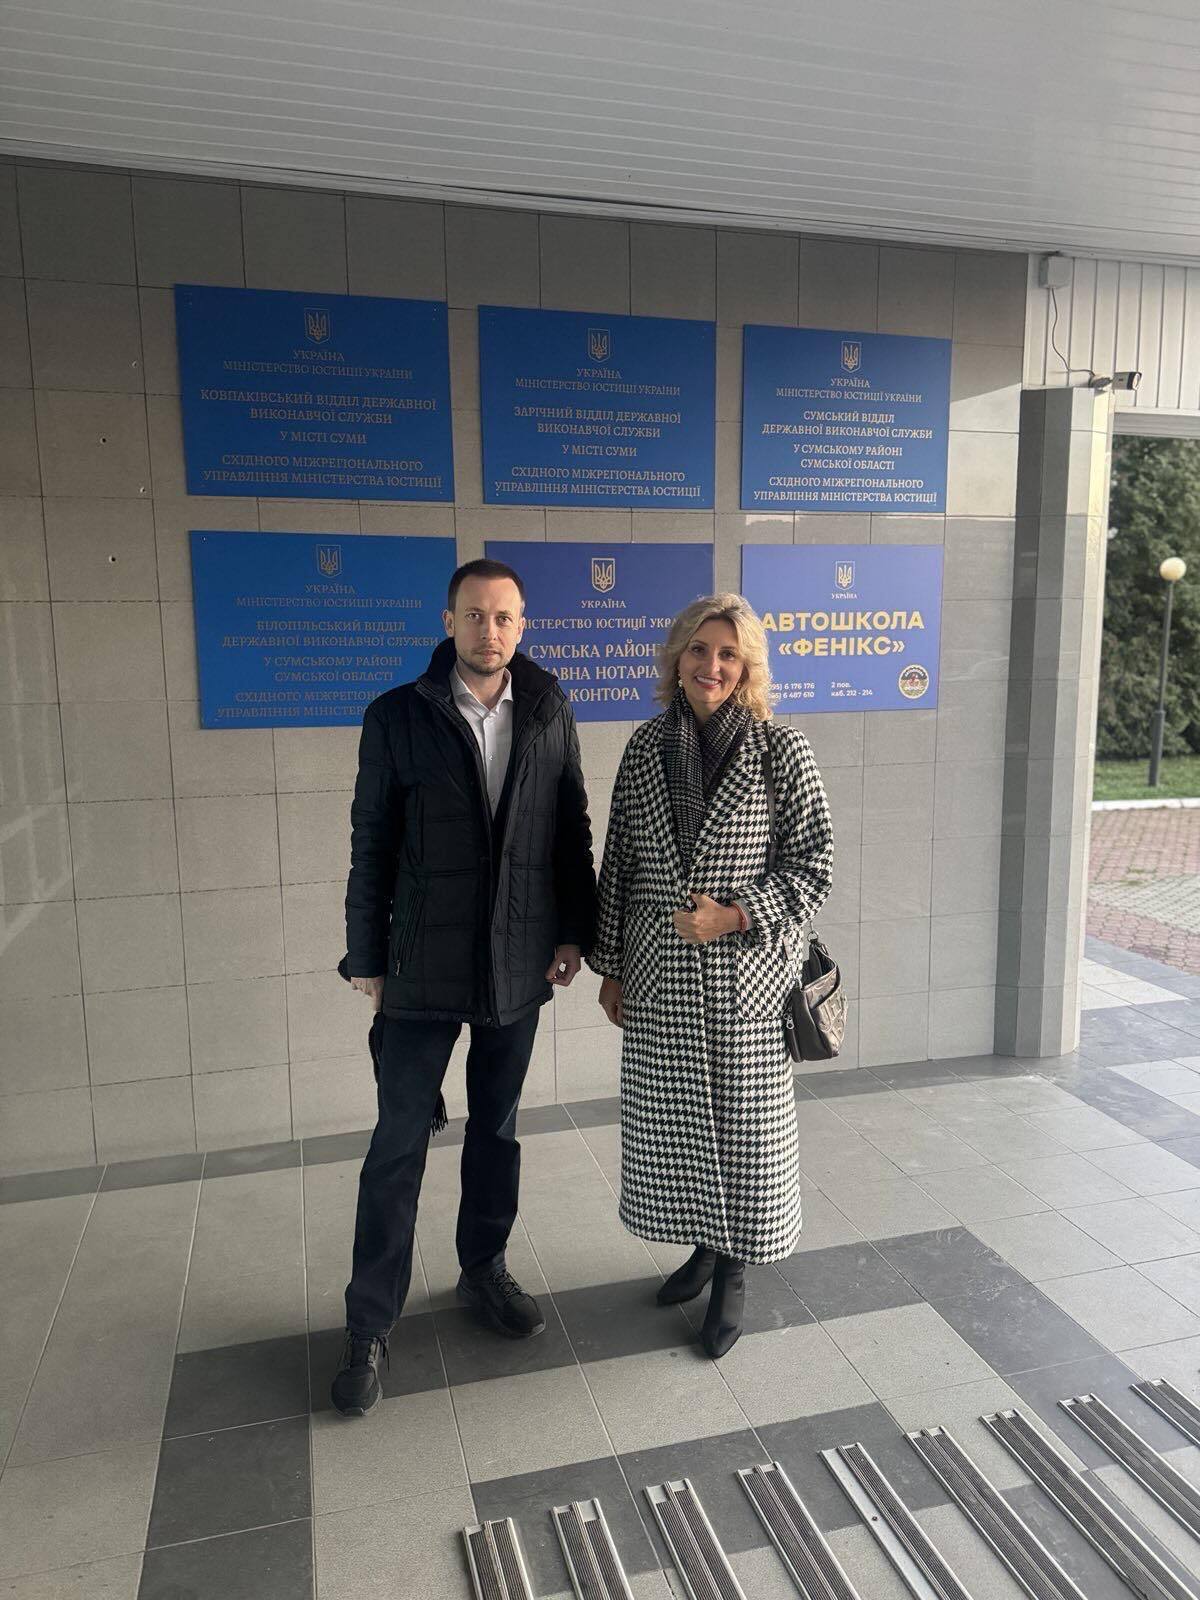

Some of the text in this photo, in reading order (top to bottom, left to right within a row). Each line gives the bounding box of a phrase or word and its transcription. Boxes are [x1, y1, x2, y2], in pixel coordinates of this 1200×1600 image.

[293, 350, 344, 362] УКРАЇНА
[223, 361, 412, 380] МІНІСТЕРСТВО ЮСТИЦІЇ УКРАЇНИ
[577, 367, 621, 379] УКРАЇНА
[515, 378, 680, 395] МІНІСТЕРСТВО ЮСТИЦІЇ УКРАЇНИ
[830, 378, 870, 388] УКРАЇНА
[201, 390, 436, 411] КОВПАКІВСЬКИЙ ВІДДІЛ ДЕРЖАВНОЇ
[776, 388, 921, 402] МІНІСТЕРСТВО ЮСТИЦІЇ УКРАЇНИ
[250, 408, 392, 424] ВИКОНАВЧОЇ СЛУЖБИ
[514, 406, 680, 423] ЗАРІЧНИЙ ВІДДІЛ ДЕРЖАВНОЇ
[804, 411, 894, 423] СУМСЬКИЙ ВІДДІЛ
[280, 431, 366, 444] У МІСТІ СУМИ
[538, 423, 660, 438] ВИКОНАВЧОЇ СЛУЖБИ
[762, 424, 932, 438] ДЕРЖАВНОЇ ВИКОНАВЧОЇ СЛУЖБИ
[562, 445, 637, 456] У МІСТІ СУМИ
[794, 444, 902, 456] У СУМСЬКОМУ РАЙОНІ
[222, 455, 423, 472] СХІДНОГО МІЖРЕГІОНАЛЬНОГО
[801, 459, 894, 469] СУМСЬКОЇ ОБЛАСТІ
[203, 471, 441, 488] УПРАВЛІННЯ МІНІСТЕРСТВА ЮСТИЦІЇ
[512, 467, 685, 481] СХІДНОГО МІЖРЕГІОНАЛЬНОГО
[495, 482, 701, 496] УПРАВЛІННЯ МІНІСТЕРСТВА ЮСТИЦІЇ
[769, 477, 923, 488] СХІДНОГО МІЖРЕГІОНАЛЬНОГО
[754, 491, 936, 503] УПРАВЛІННЯ МІНІСТЕРСТВА ЮСТИЦІЇ
[581, 600, 626, 608] УКРАЇНА
[525, 617, 676, 631] ІСТЕРСТВО ЮСТИЦІЇ УКРА
[761, 611, 924, 631] АВТОШКОЛА
[528, 639, 661, 659] СУМСЬКА РАЙОН
[778, 636, 905, 656] «ФЕНІКС»
[543, 665, 660, 681] АВНА НОТАРІА
[570, 687, 640, 702] КОНТОРА
